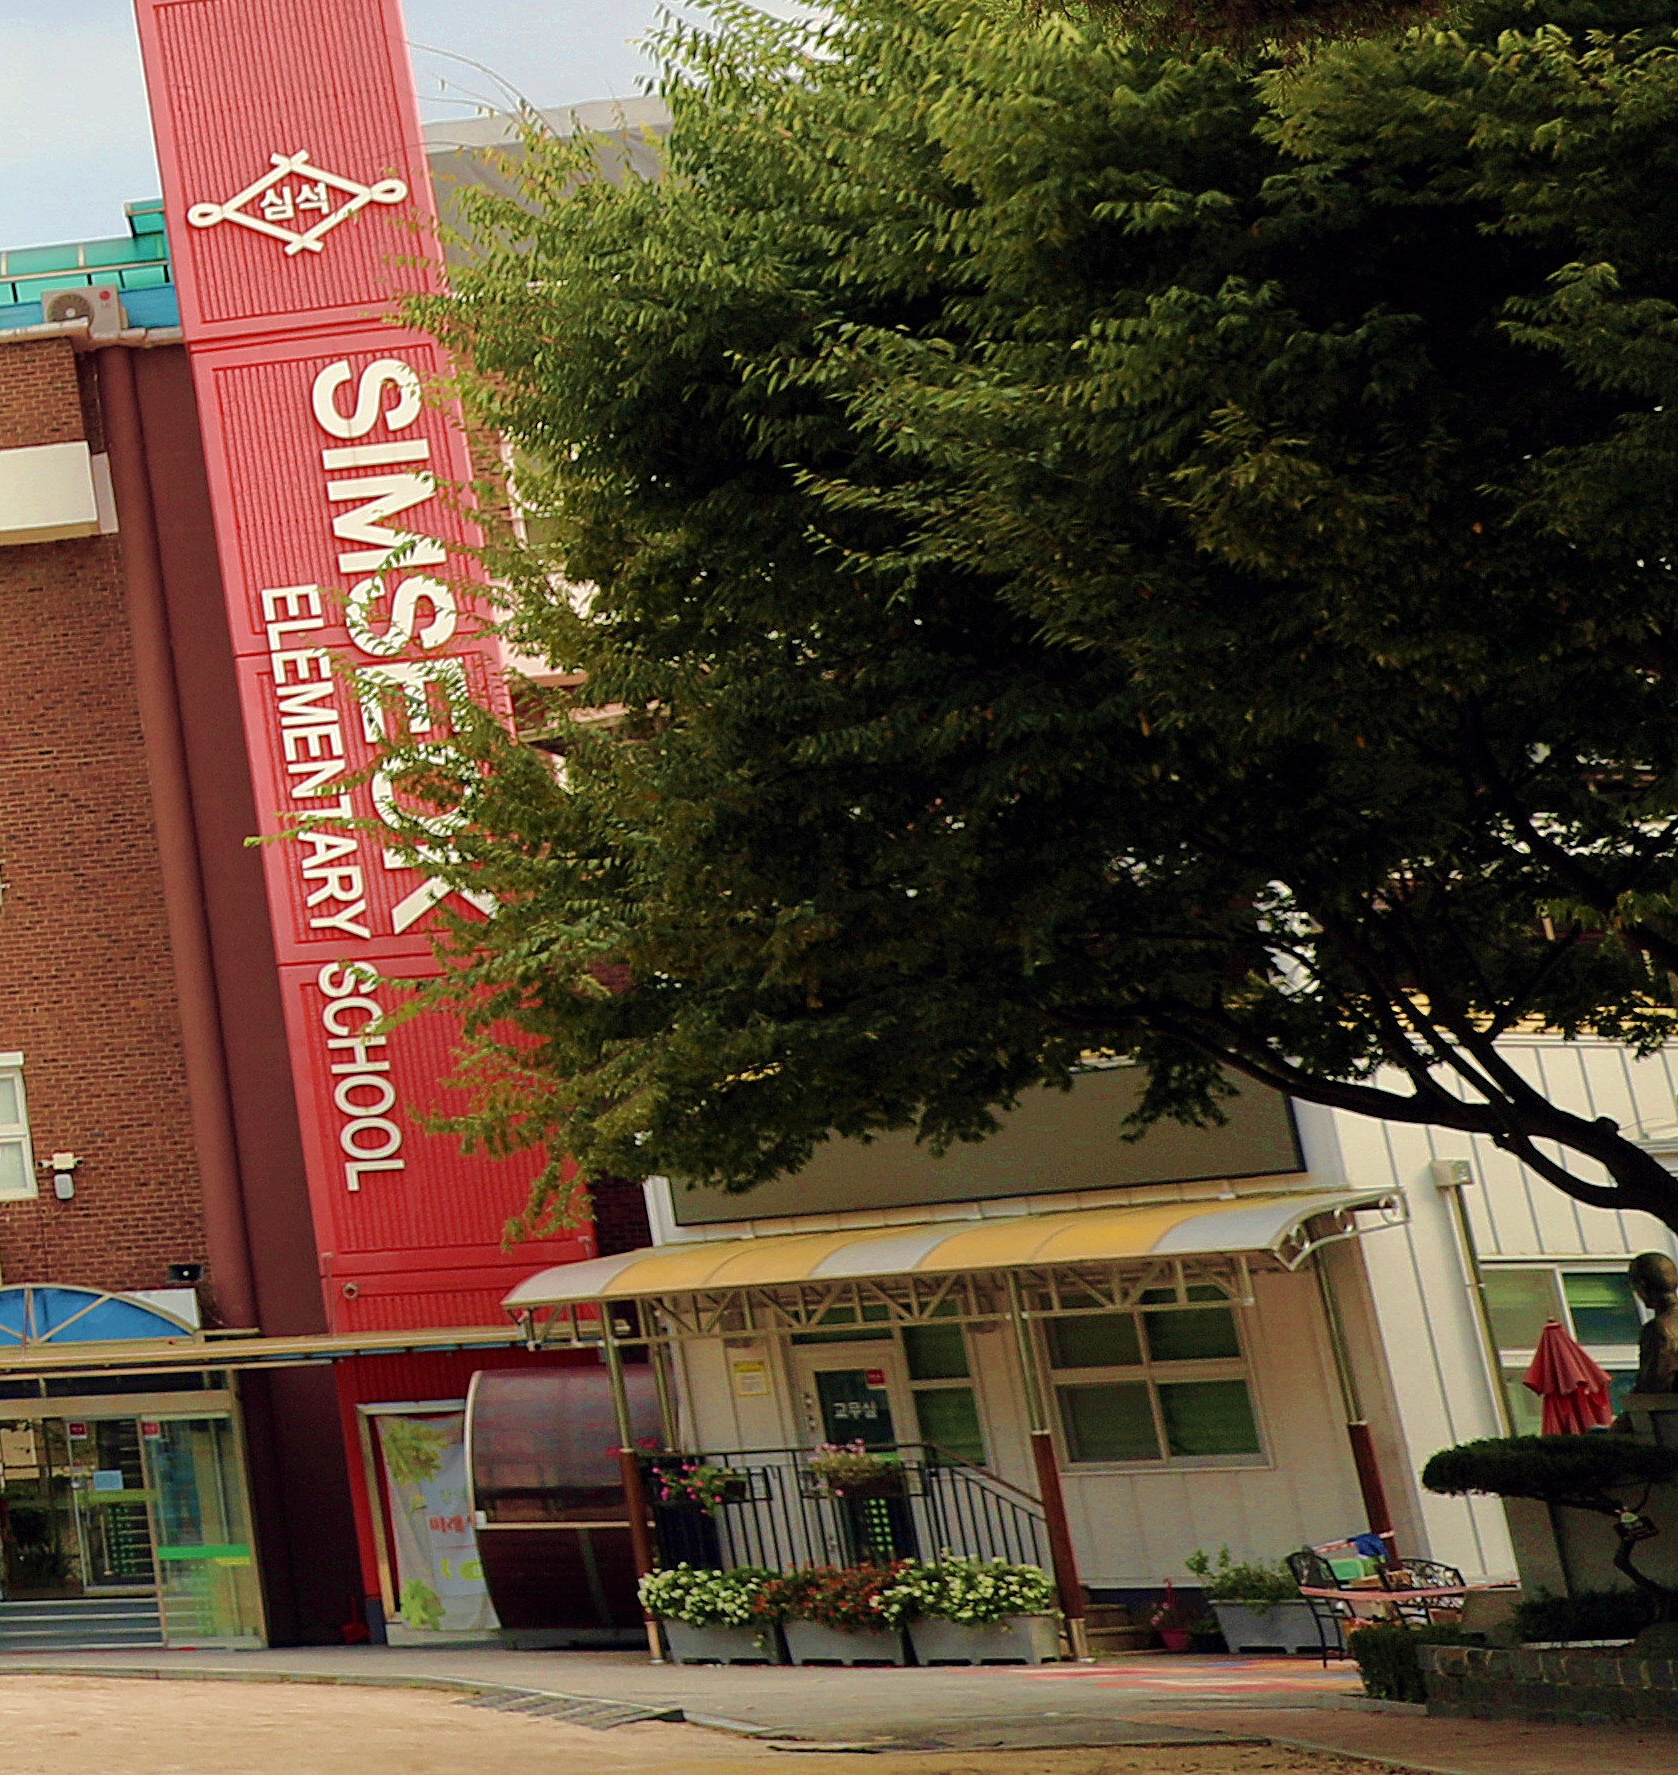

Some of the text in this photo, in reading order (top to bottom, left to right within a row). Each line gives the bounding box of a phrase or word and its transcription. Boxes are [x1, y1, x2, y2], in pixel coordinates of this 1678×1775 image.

[260, 182, 330, 221] 심석
[261, 583, 406, 1192] ELEMENTARY SCHOOL
[832, 1400, 878, 1421] 교무실
